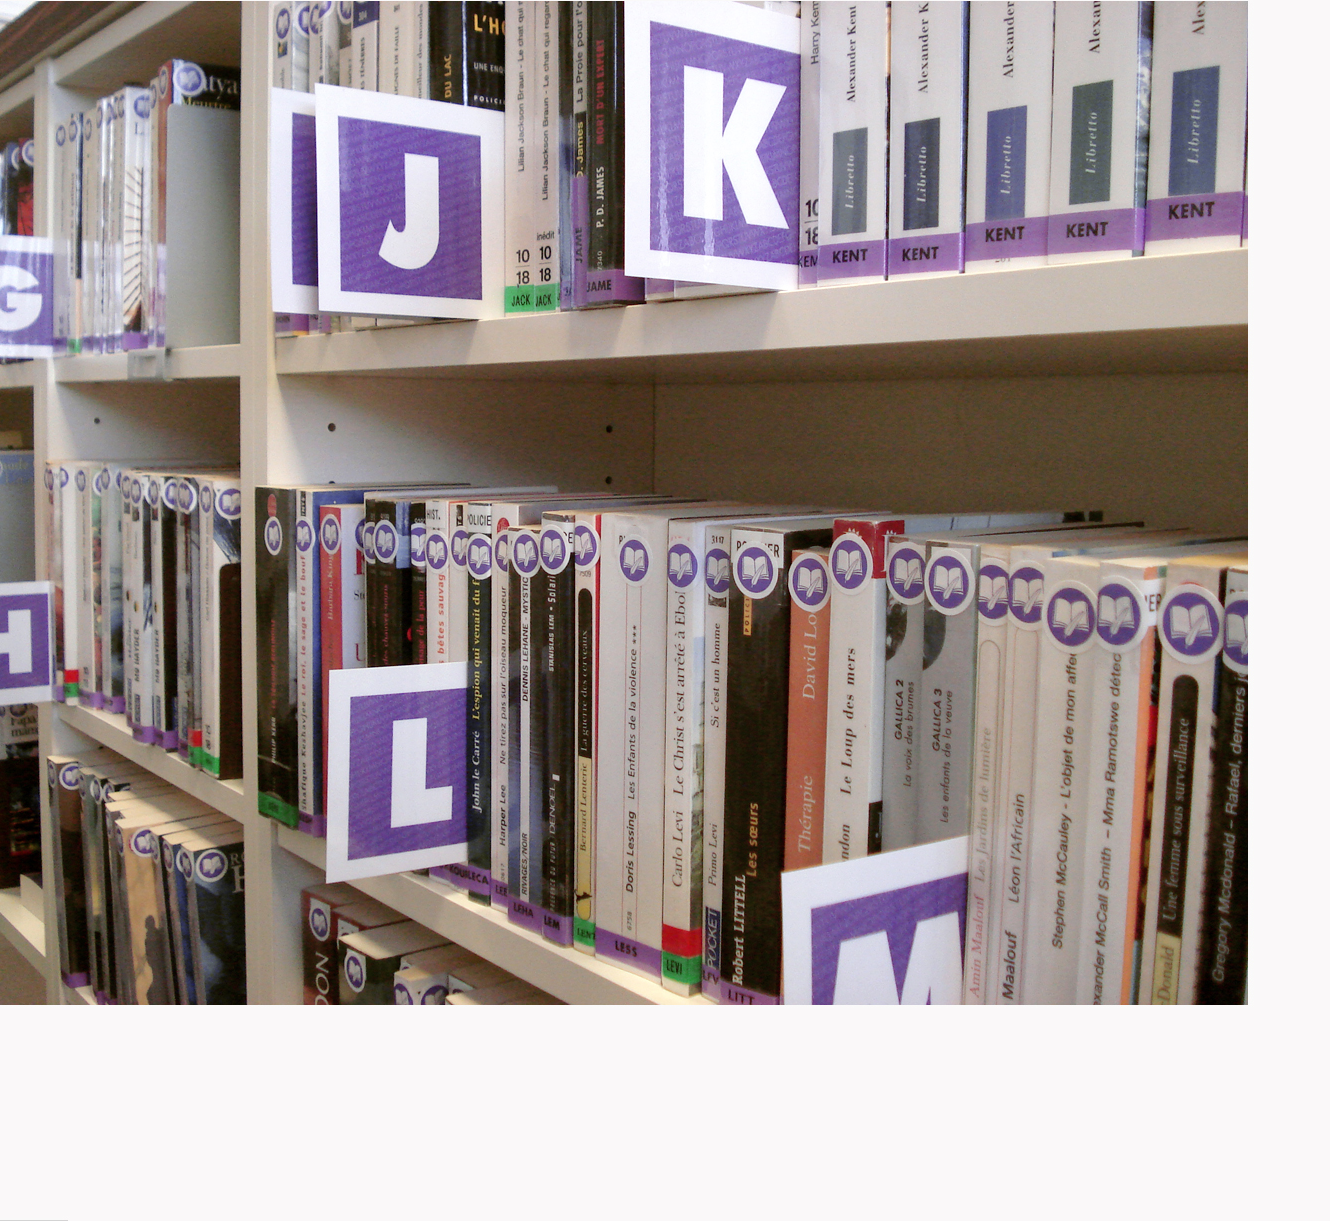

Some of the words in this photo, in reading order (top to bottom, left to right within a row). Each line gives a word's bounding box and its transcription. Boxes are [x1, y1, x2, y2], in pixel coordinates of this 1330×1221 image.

[576, 20, 584, 47] pour
[846, 5, 856, 35] Kent
[810, 31, 820, 65] Harry
[918, 19, 929, 93] Alexander
[1002, 1, 1015, 78] Alexander
[473, 62, 488, 71] UNE
[596, 39, 604, 78] EXPERT
[846, 39, 856, 102] Alexander
[576, 121, 584, 163] James
[596, 114, 604, 145] MORT
[1085, 111, 1098, 174] Libretto
[1187, 99, 1202, 164] Libretto
[683, 65, 790, 230] K
[1000, 135, 1011, 195] Libretto
[596, 166, 604, 200] JAMES
[845, 154, 855, 209] Libretto
[916, 145, 927, 203] Libretto
[378, 152, 440, 270] J
[1168, 202, 1215, 221] KENT
[536, 232, 555, 241] inédit
[985, 226, 1025, 242] KENT
[1066, 222, 1108, 239] KENT
[516, 249, 530, 263] 10
[539, 246, 552, 260] 10
[832, 248, 868, 264] KENT
[902, 246, 940, 262] KENT
[516, 271, 530, 285] 18
[539, 267, 552, 282] 18
[587, 279, 612, 292] JAME
[511, 294, 531, 307] JACK
[535, 293, 552, 307] JACK
[472, 590, 480, 605] du
[547, 576, 556, 603] Solari
[472, 609, 480, 645] venait
[711, 623, 720, 665] homme
[472, 648, 482, 668] qui
[628, 649, 637, 697] violence
[674, 643, 685, 687] arrêté
[802, 644, 816, 700] David
[846, 648, 856, 685] mers
[713, 669, 720, 683] un
[934, 688, 942, 696] 3
[472, 671, 482, 720] L'espion
[626, 701, 636, 711] la
[673, 690, 684, 723] s'est
[711, 688, 720, 712] c'est
[843, 694, 854, 719] des
[905, 682, 915, 722] brumes
[944, 690, 953, 724] veuve
[1066, 689, 1076, 722] mon
[626, 715, 636, 730] de
[710, 716, 719, 728] Si
[895, 691, 903, 740] GALLICA
[932, 700, 941, 751] GALLICA
[942, 728, 951, 738] la
[1230, 687, 1246, 754] derniers
[472, 730, 480, 766] Carré
[673, 726, 684, 771] Christ
[841, 728, 857, 768] Loup
[904, 725, 913, 744] des
[942, 743, 951, 758] de
[1063, 726, 1074, 745] de
[1104, 702, 1120, 783] Ramotswe
[499, 751, 506, 764] Ne
[626, 734, 636, 777] Enfants
[904, 749, 913, 770] voix
[980, 728, 991, 780] lumière
[1173, 718, 1190, 802] surveillance
[390, 717, 453, 829] L
[472, 768, 480, 780] le
[672, 776, 683, 796] Le
[840, 776, 852, 795] Le
[940, 762, 951, 802] enfants
[1060, 749, 1075, 798] L'objet
[472, 783, 482, 813] John
[627, 782, 635, 800] Les
[1102, 787, 1116, 826] Mma
[672, 810, 683, 843] Levi
[749, 802, 759, 846] sœurs
[798, 775, 816, 853] Thérapie
[940, 806, 950, 823] Les
[1010, 794, 1025, 861] l'Africain
[1172, 806, 1183, 836] sous
[626, 811, 636, 856] Lessing
[708, 823, 717, 848] Levi
[1055, 813, 1072, 885] McCauley
[626, 860, 634, 893] Doris
[672, 847, 683, 887] Carlo
[708, 852, 717, 886] Primo
[747, 852, 758, 877] Les
[1098, 847, 1111, 891] Smith
[1164, 840, 1182, 888] femme
[1218, 832, 1236, 914] Mcdonald
[1008, 866, 1020, 903] Léon
[734, 874, 746, 933] LITTELL
[1052, 890, 1066, 949] Stephen
[1095, 894, 1109, 947] McCall
[1162, 892, 1178, 920] Une
[544, 915, 560, 931] LEM
[707, 909, 718, 970] POCKET
[971, 893, 984, 955] Maalouf
[615, 940, 637, 958] LESS
[732, 937, 744, 985] Robert
[833, 911, 964, 1005] M
[1002, 930, 1017, 1000] Maalouf
[1212, 917, 1231, 982] Gregory
[666, 959, 683, 975] LEVI
[970, 960, 981, 998] Amin
